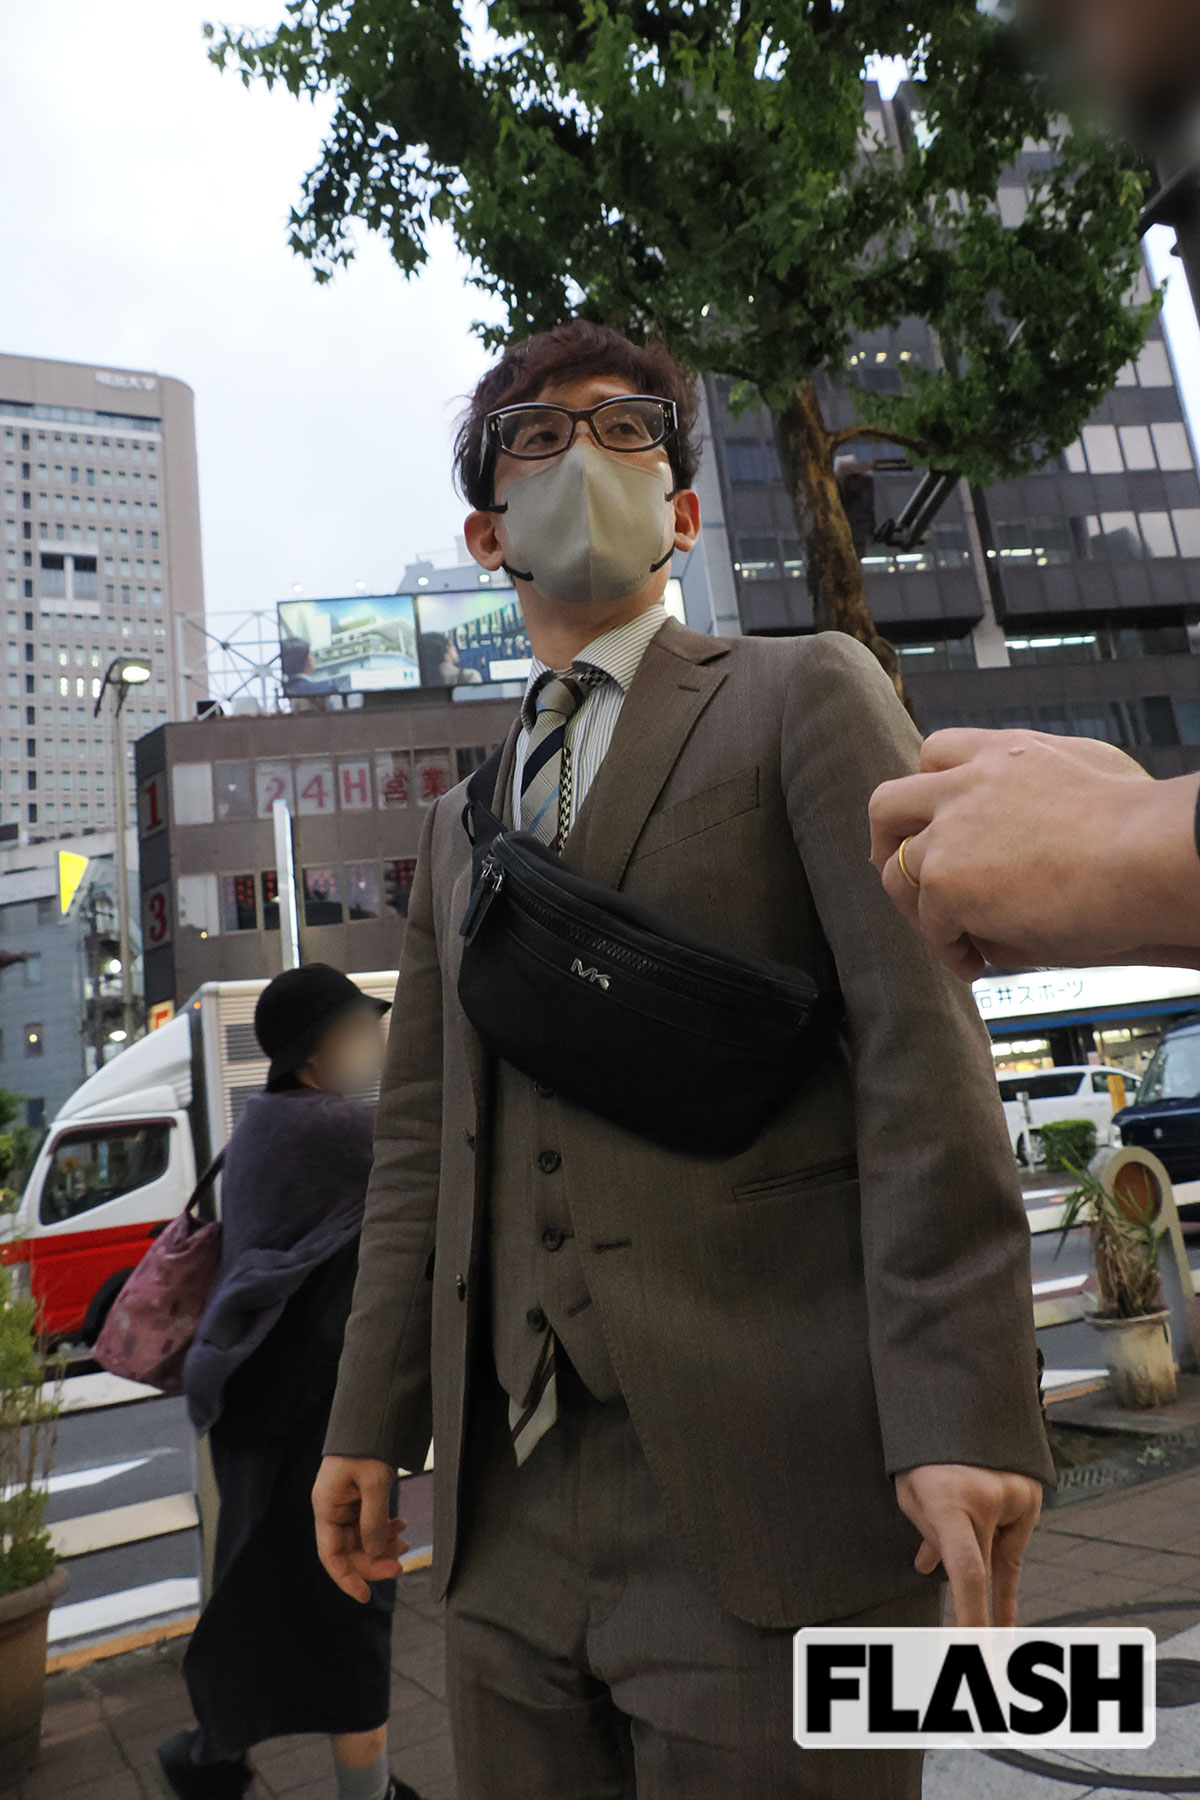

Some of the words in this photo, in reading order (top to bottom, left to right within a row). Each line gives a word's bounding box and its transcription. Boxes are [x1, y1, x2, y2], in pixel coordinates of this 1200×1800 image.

[145, 781, 162, 830] 1
[149, 892, 168, 942] 3
[570, 958, 611, 990] MK
